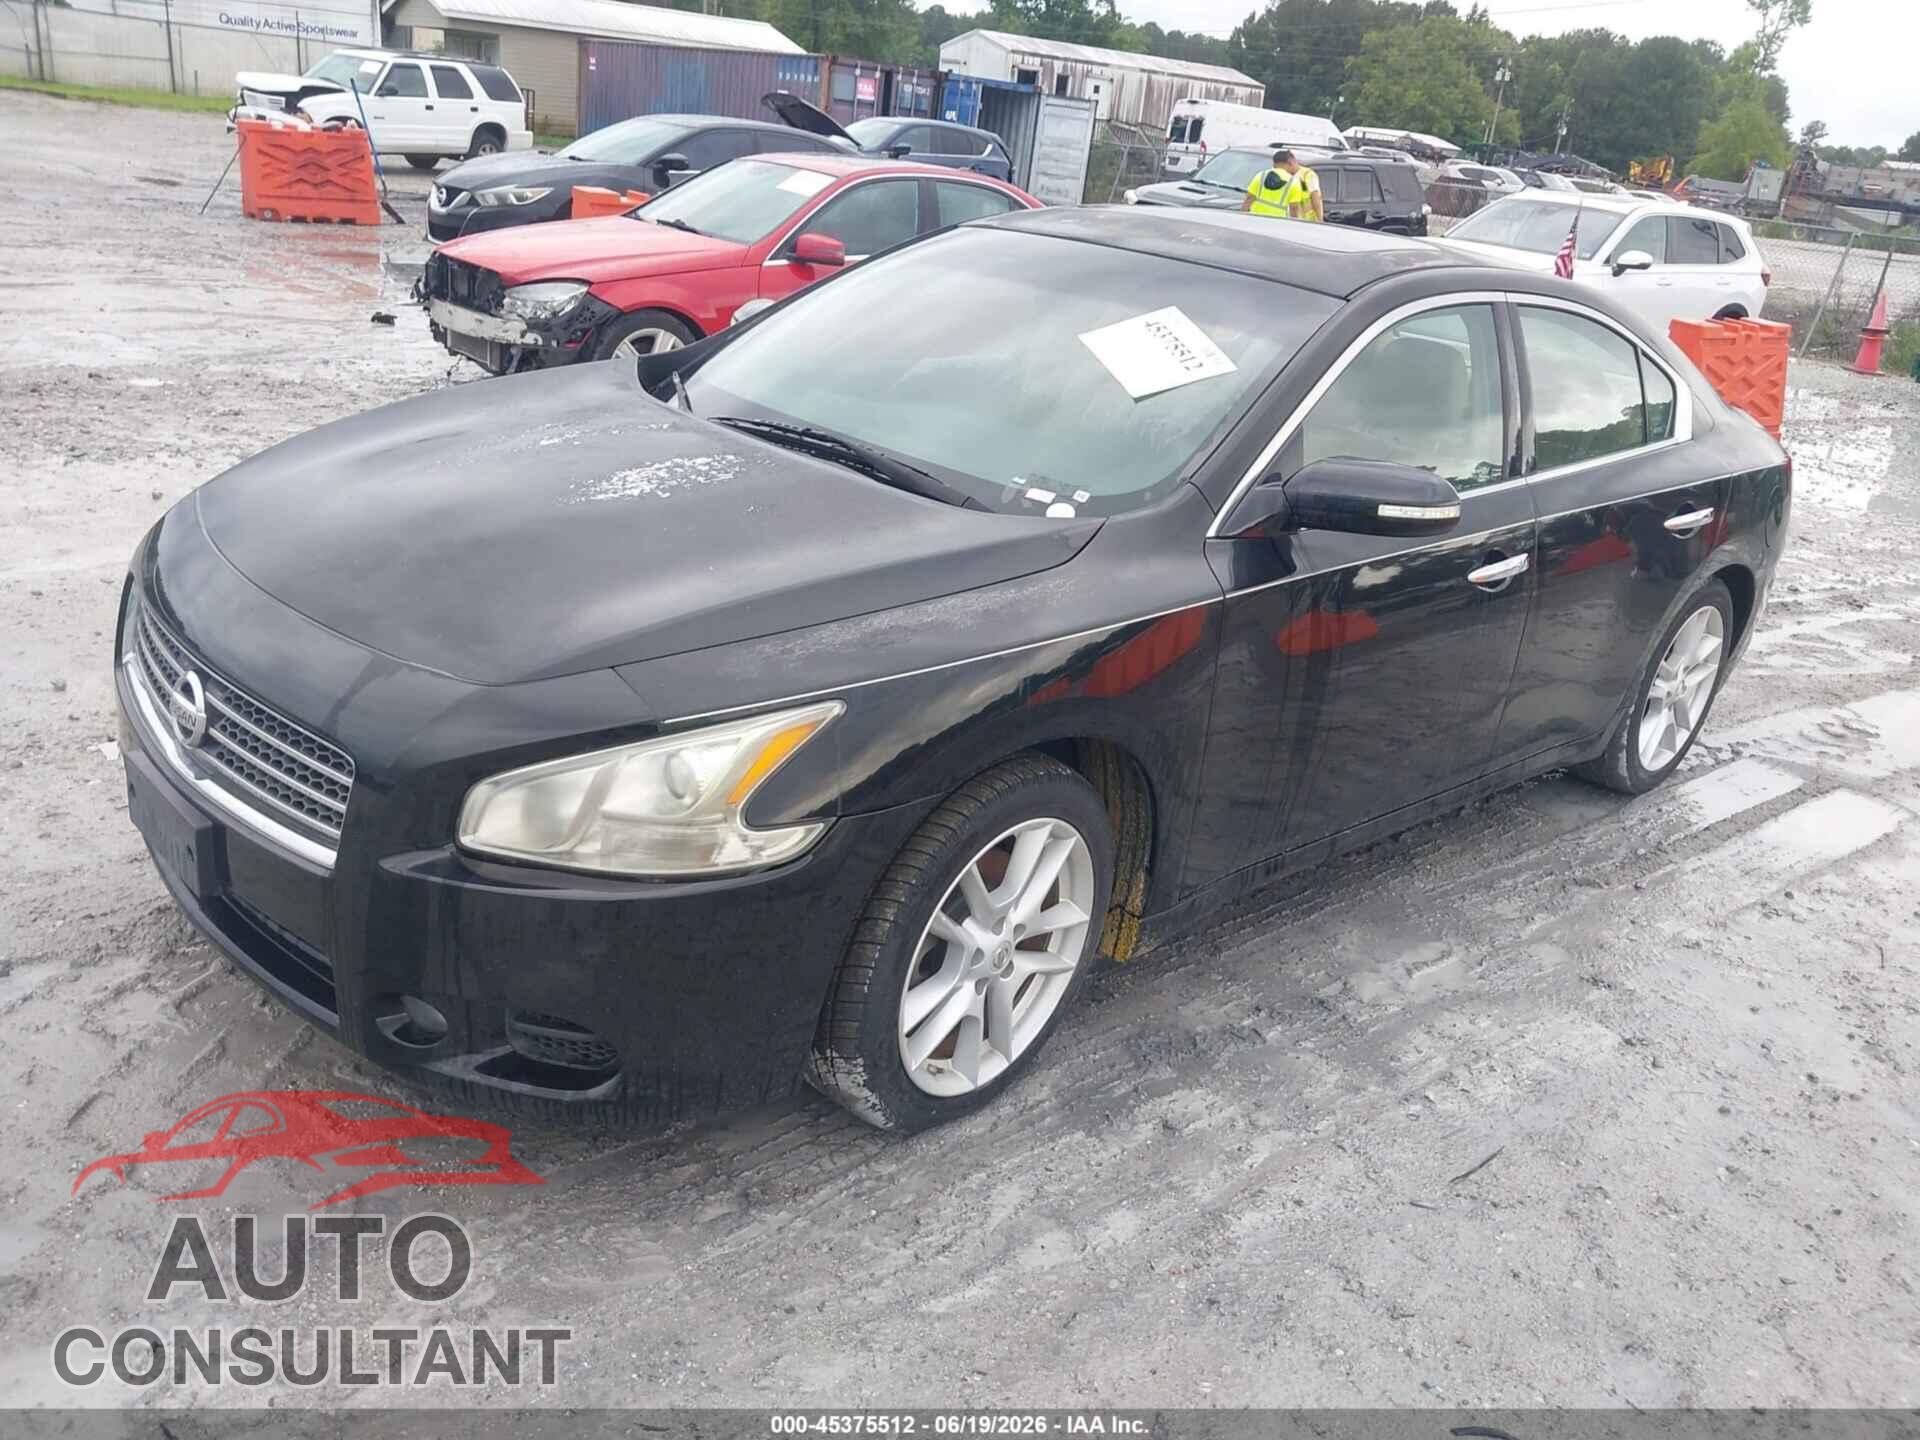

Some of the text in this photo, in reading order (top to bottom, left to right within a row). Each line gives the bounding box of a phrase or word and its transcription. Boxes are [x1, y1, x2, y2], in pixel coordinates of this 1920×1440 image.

[218, 12, 359, 38] Quality Active Sportswear
